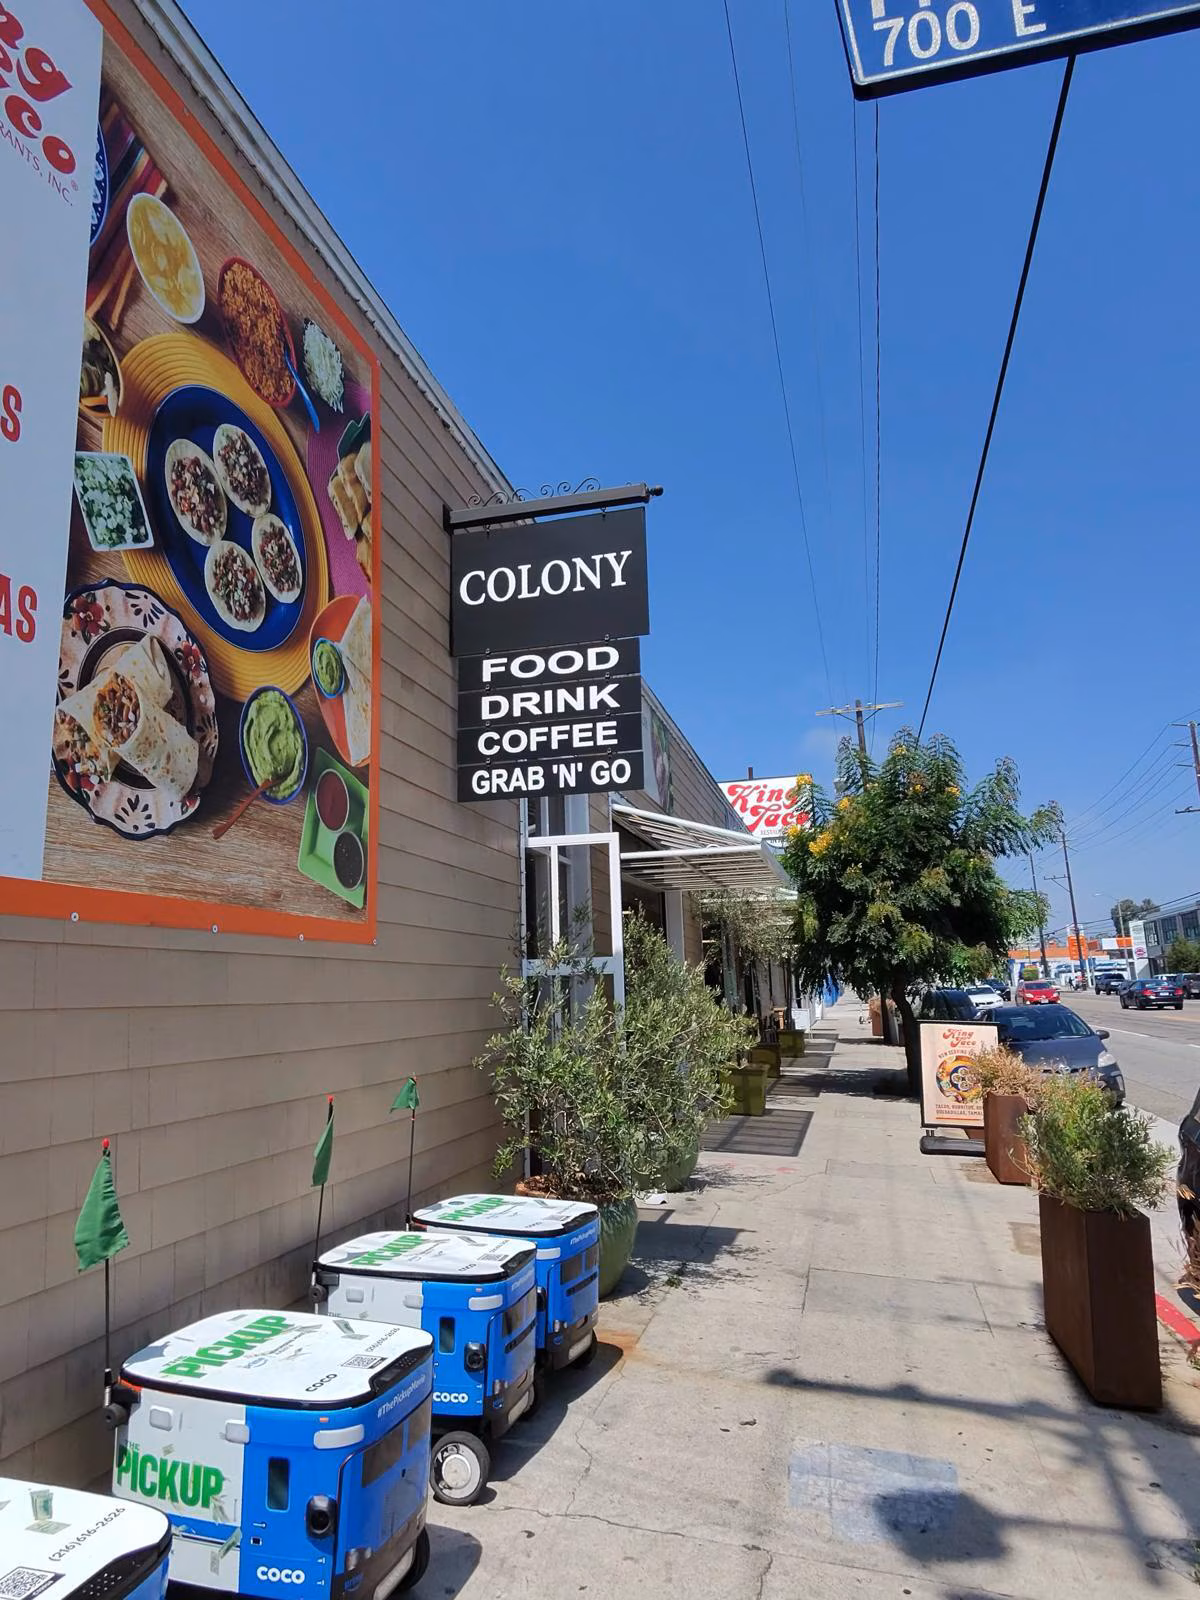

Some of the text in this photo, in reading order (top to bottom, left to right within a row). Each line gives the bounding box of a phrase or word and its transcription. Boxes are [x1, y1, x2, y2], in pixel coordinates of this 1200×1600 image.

[873, 0, 1047, 67] 700 E
[459, 550, 632, 606] COLONY
[482, 645, 620, 682] FOOD
[481, 683, 621, 720] DRINK
[477, 720, 619, 755] COFFEE
[471, 758, 631, 795] GRAB 'N' GO
[160, 1315, 295, 1379] PICKUP
[116, 1447, 224, 1509] PICKUP
[48, 1507, 126, 1563] (216)616-2626
